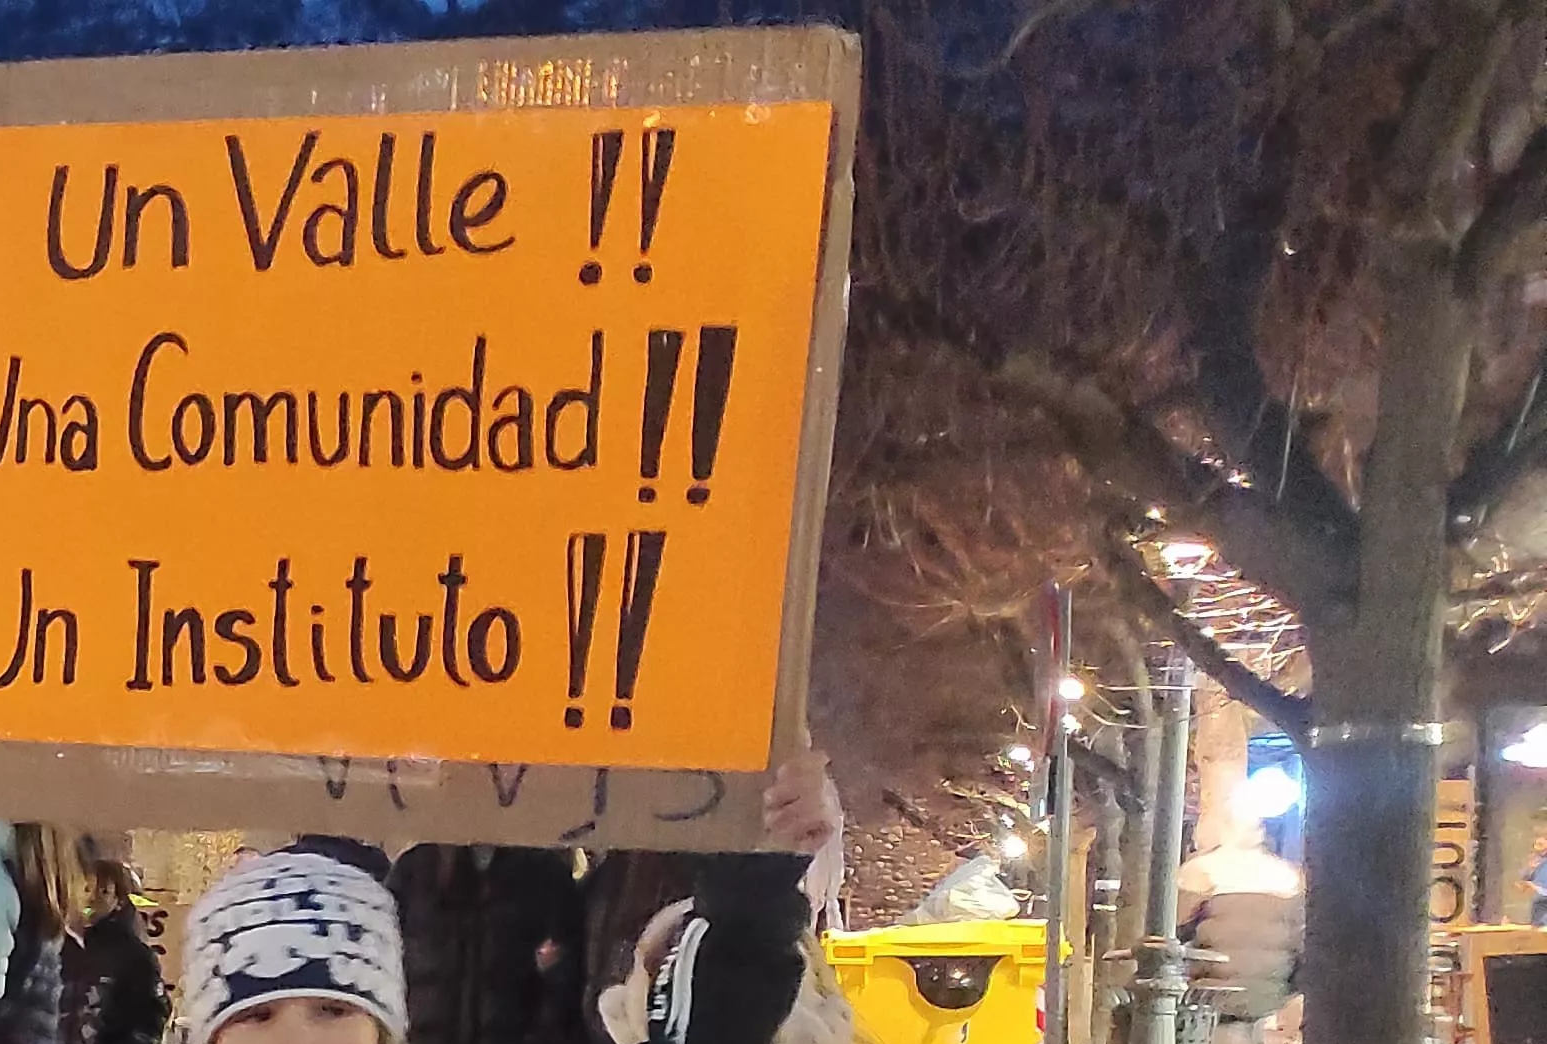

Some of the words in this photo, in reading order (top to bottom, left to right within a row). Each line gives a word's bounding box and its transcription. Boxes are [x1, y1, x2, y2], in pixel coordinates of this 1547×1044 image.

[47, 164, 190, 280] Un
[224, 131, 516, 273] Valle
[127, 330, 604, 473] Comunidad
[126, 553, 521, 691] Instituto
